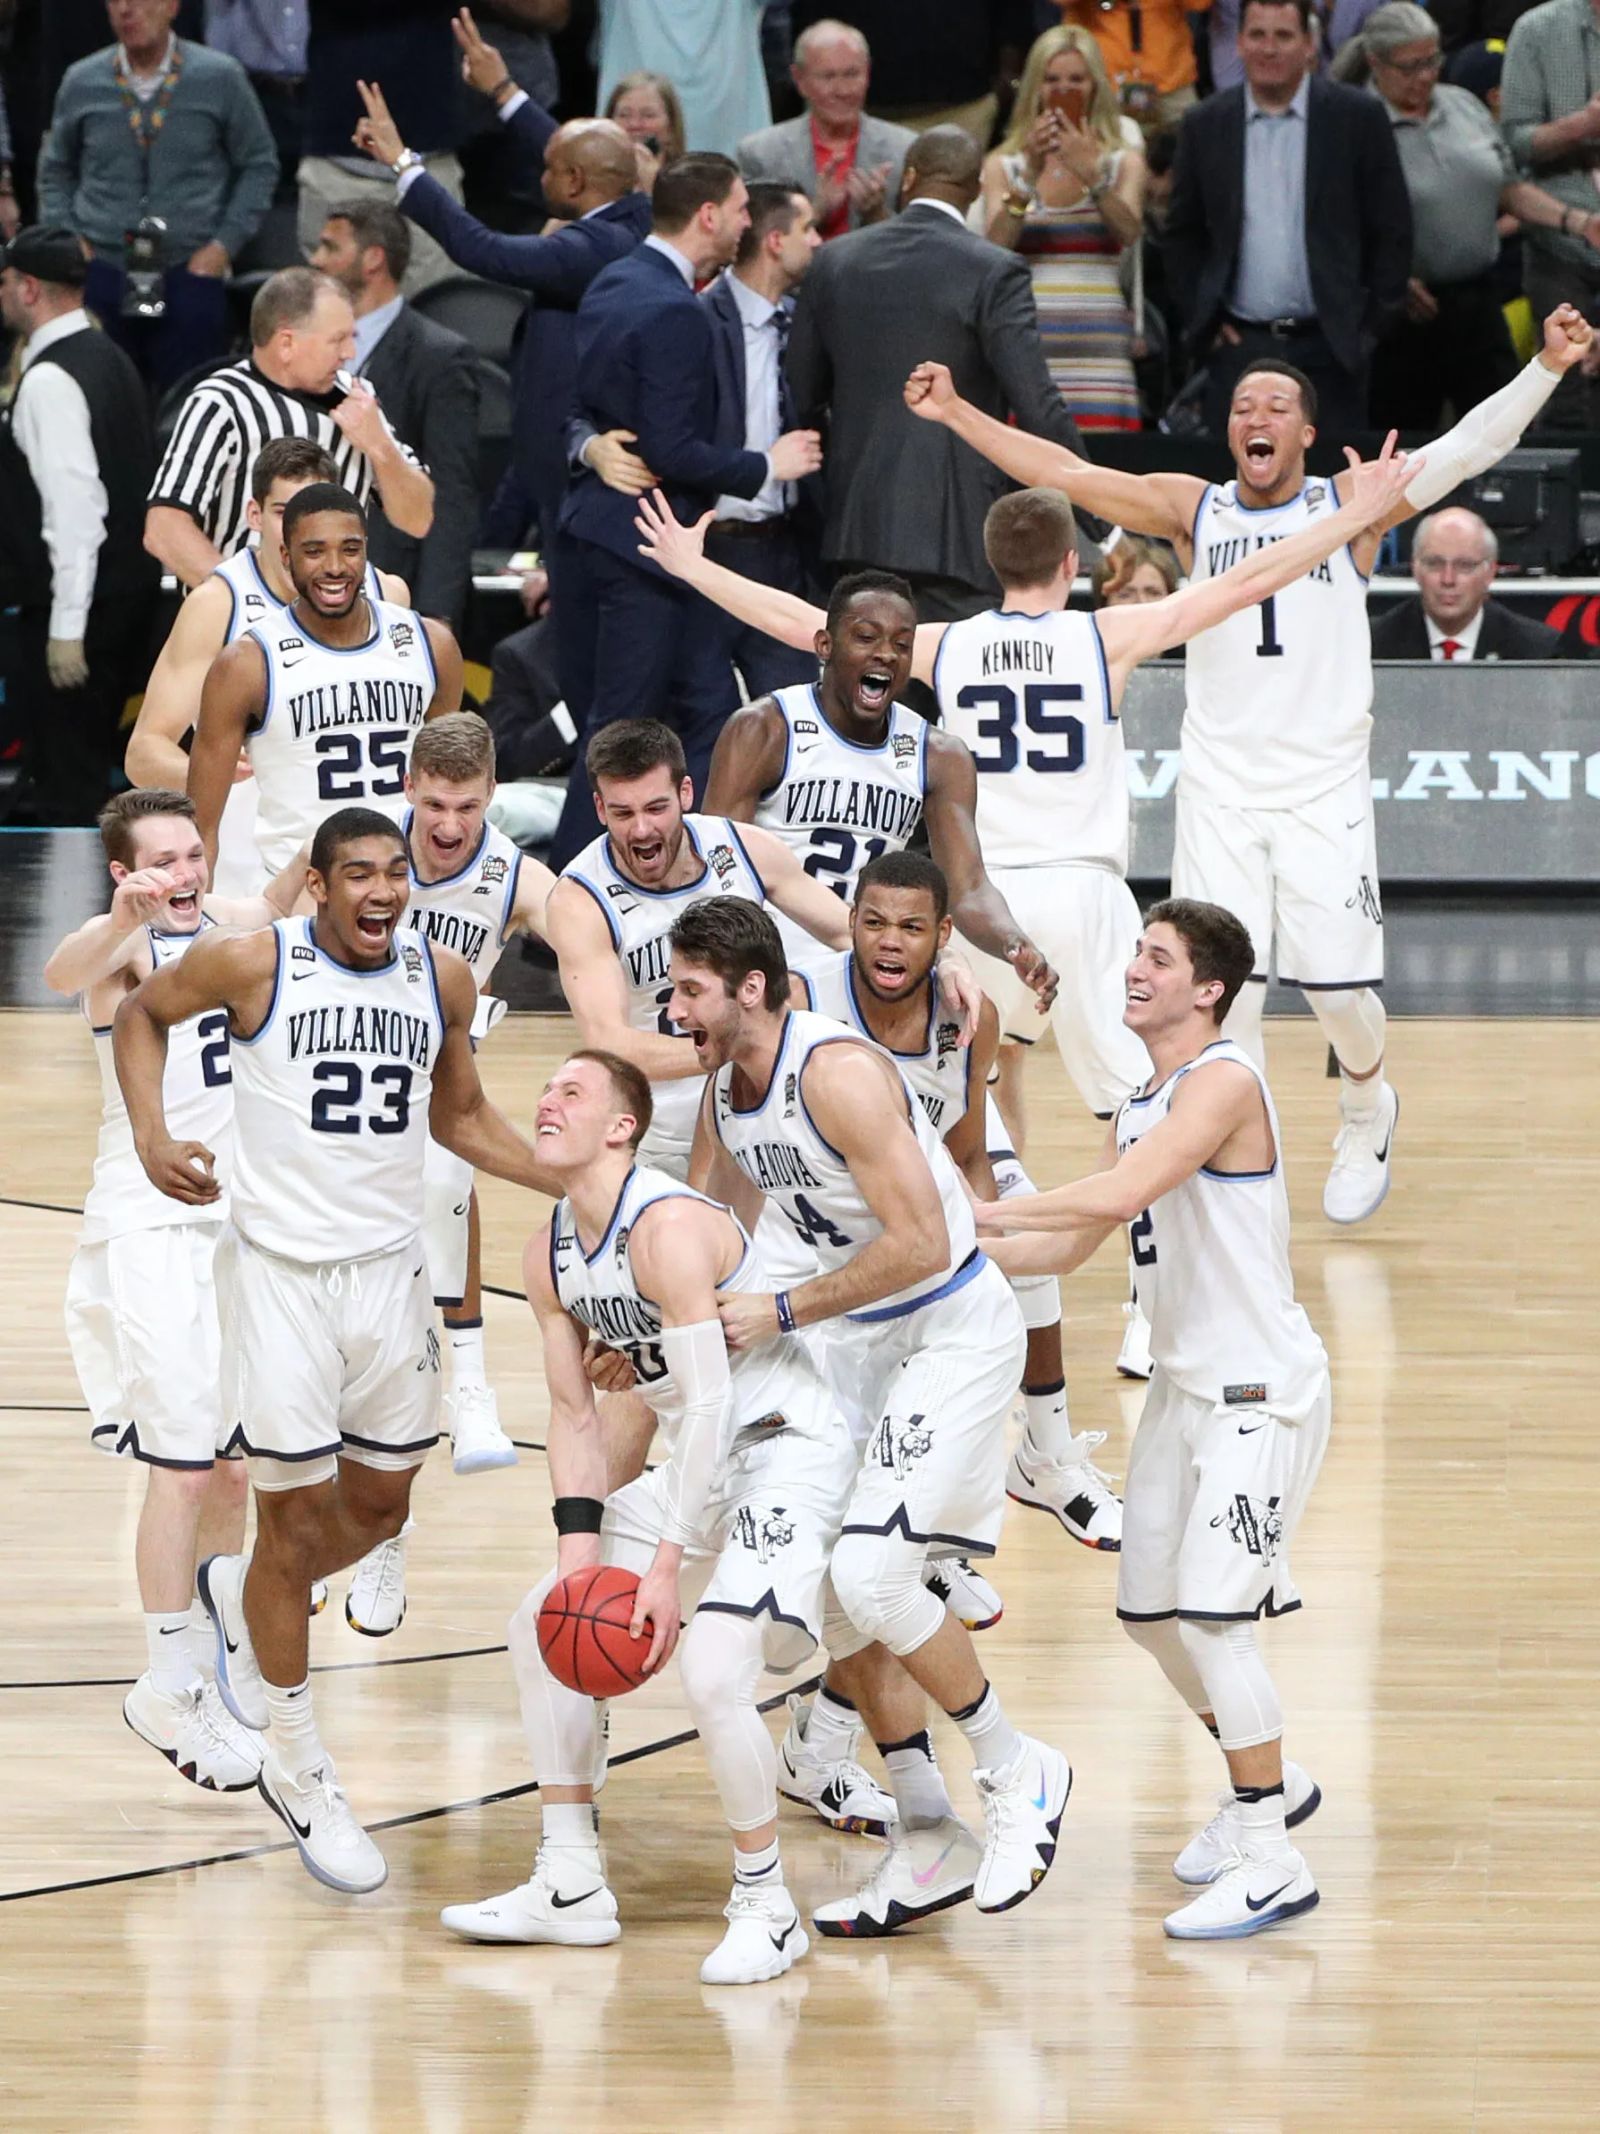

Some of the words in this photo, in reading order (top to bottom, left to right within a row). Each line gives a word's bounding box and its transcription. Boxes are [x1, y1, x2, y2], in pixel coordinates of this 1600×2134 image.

[982, 639, 1054, 677] KENNEDY
[289, 680, 424, 738] VILLANOVA
[957, 684, 1084, 773] 35
[315, 730, 409, 800] 25
[785, 780, 922, 838] VILLANOVA
[289, 1006, 429, 1067] VILLANOVA
[311, 1061, 413, 1134] 23
